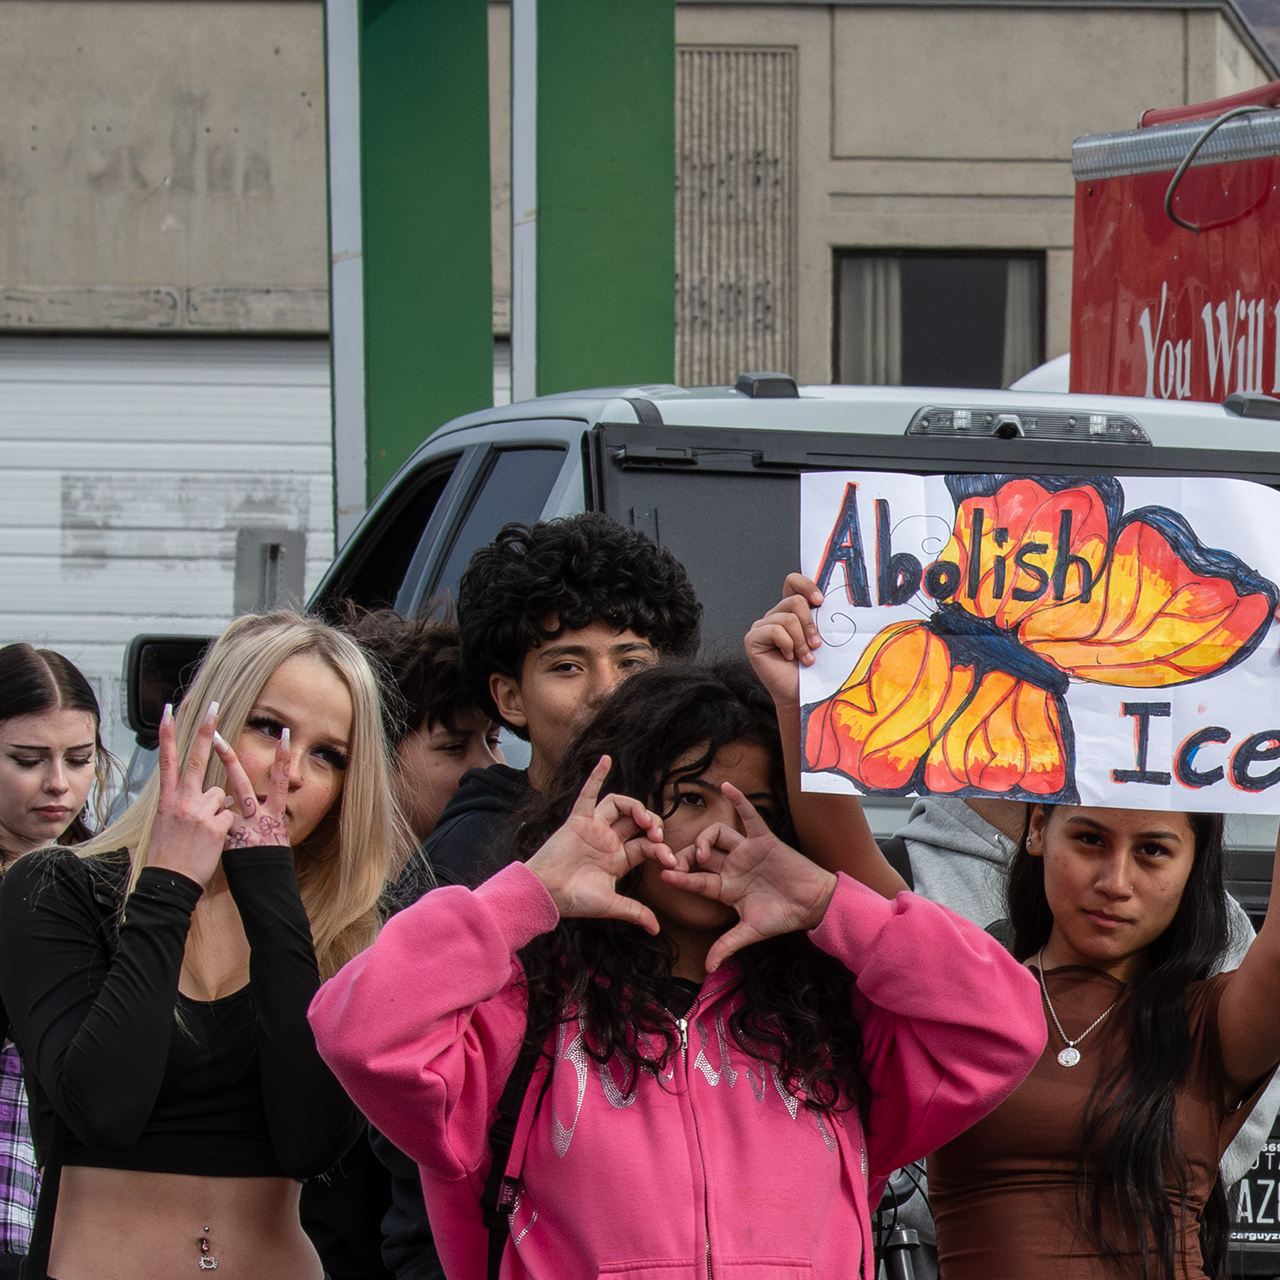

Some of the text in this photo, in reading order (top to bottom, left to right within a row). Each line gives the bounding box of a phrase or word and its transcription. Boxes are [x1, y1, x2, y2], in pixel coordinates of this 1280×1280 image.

[1139, 280, 1191, 400] You
[1201, 289, 1264, 397] Will
[815, 481, 1093, 608] Abolish
